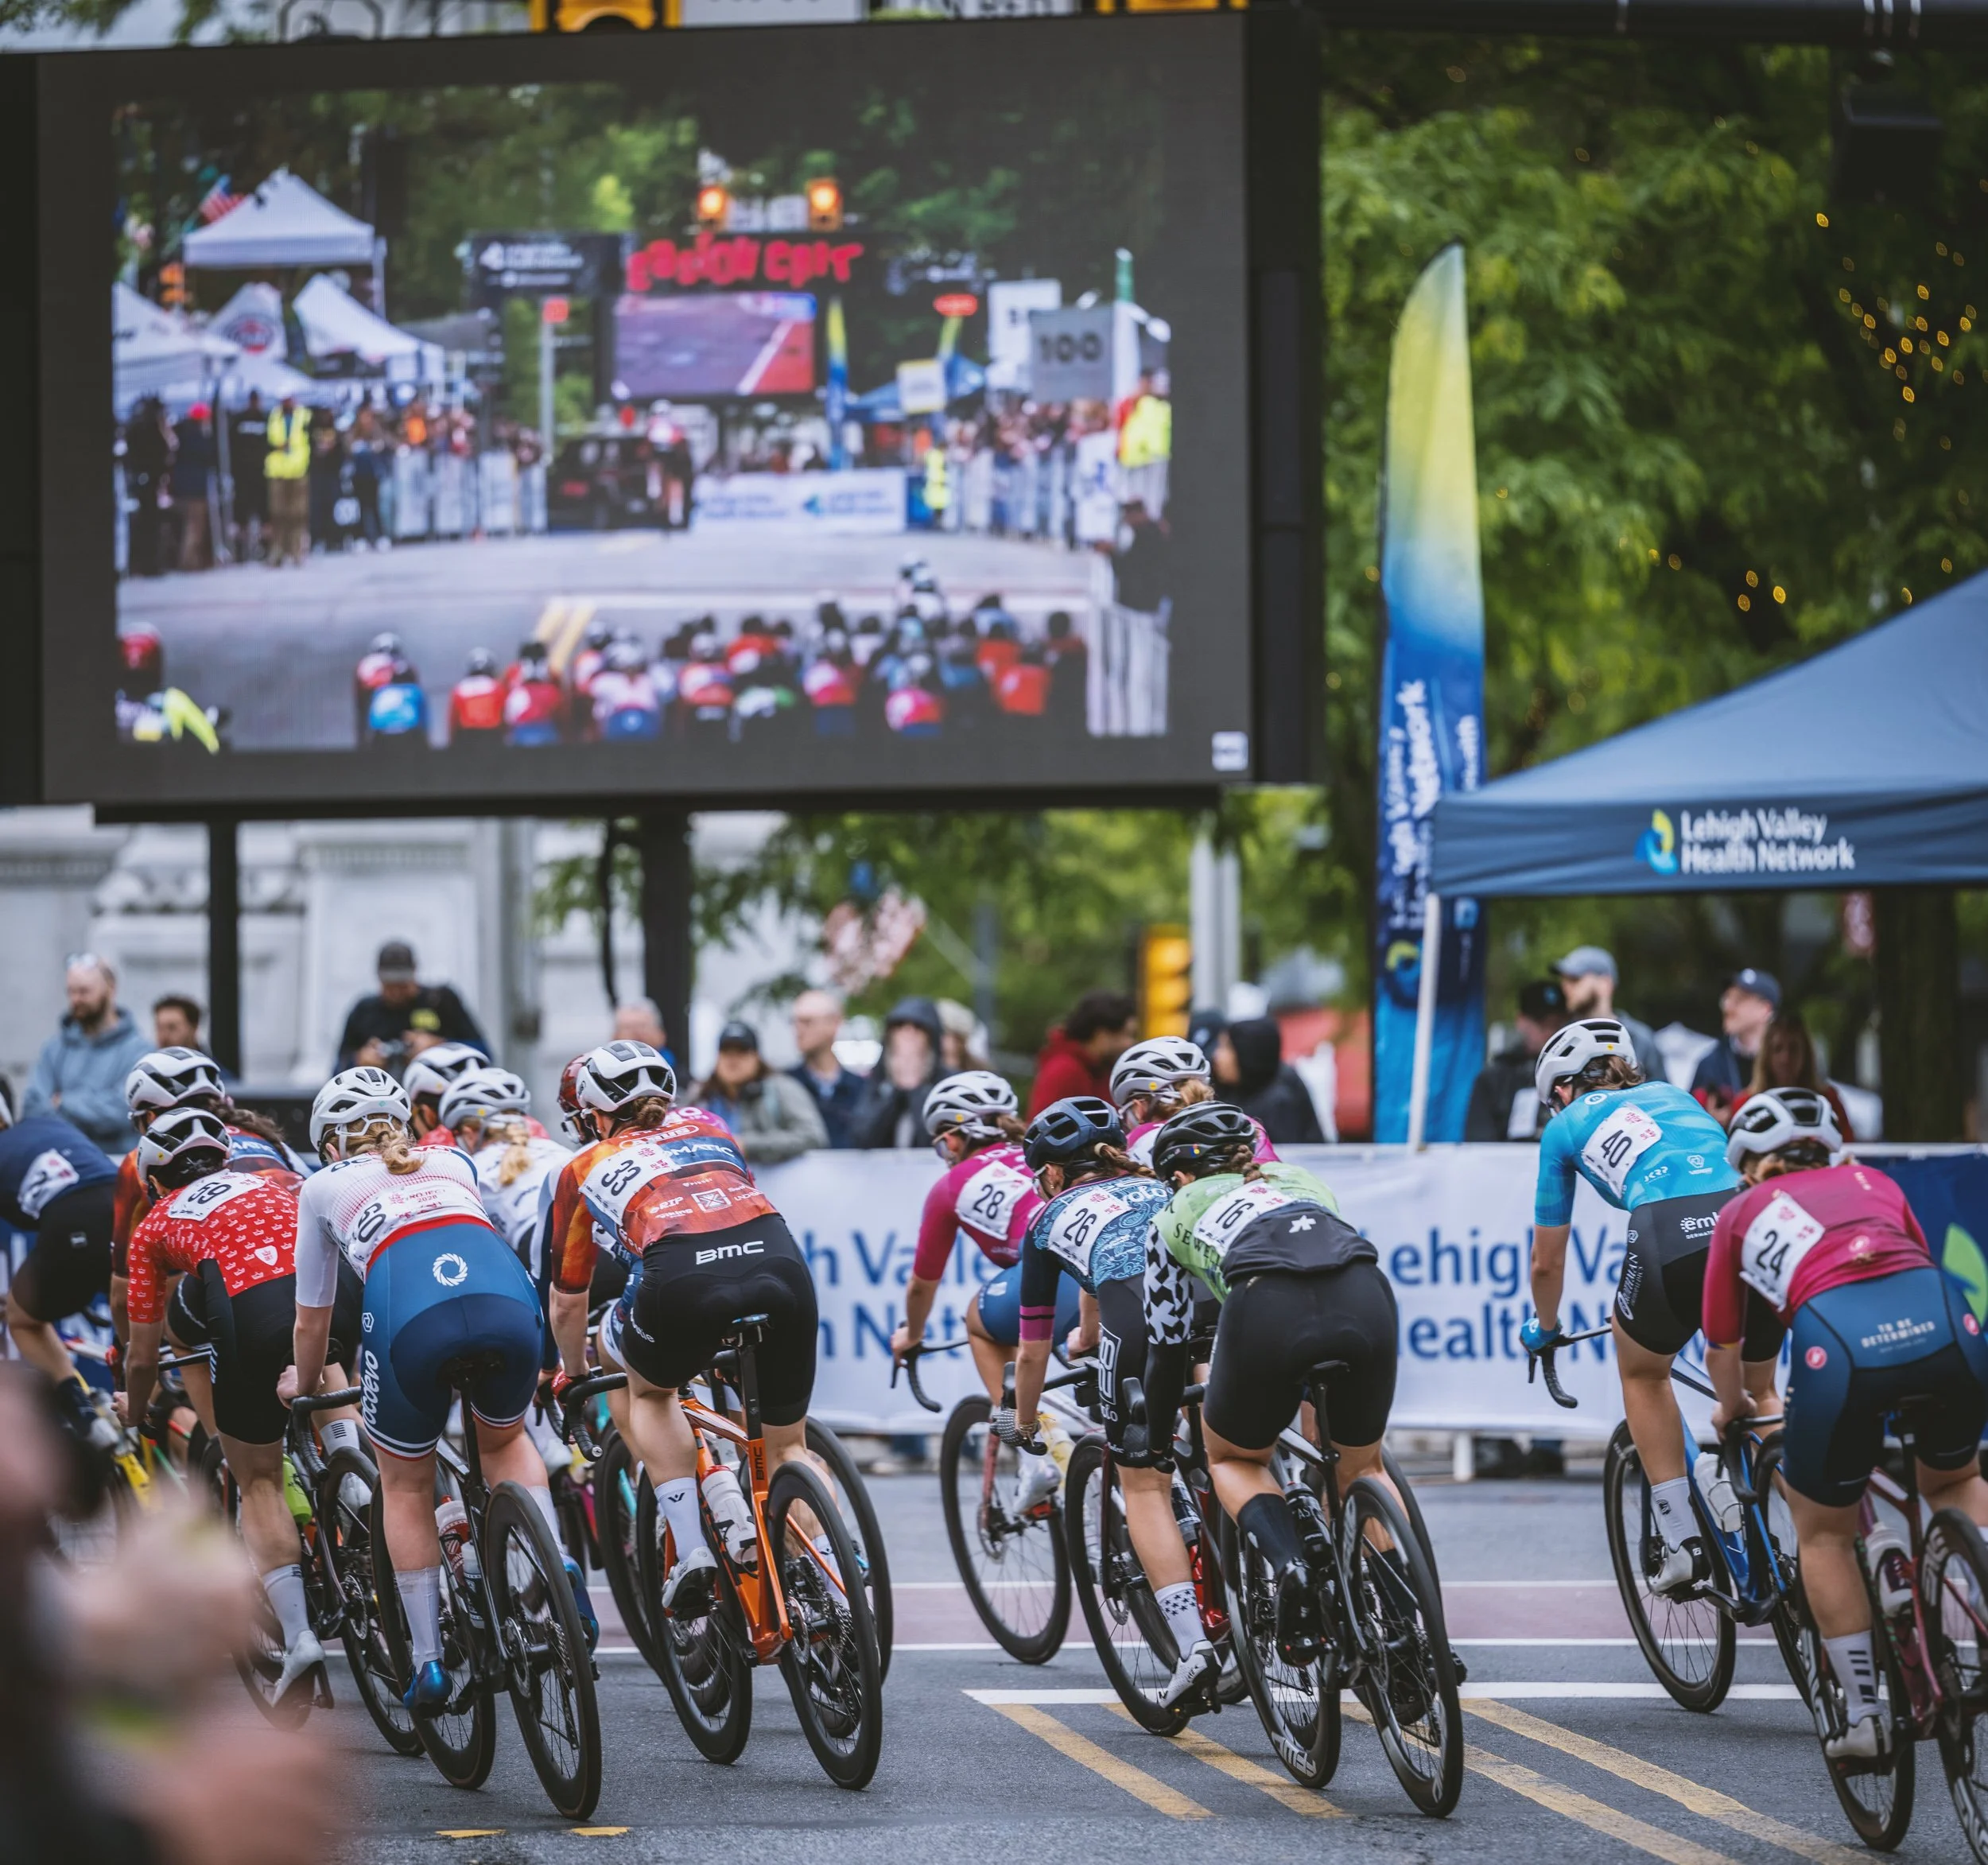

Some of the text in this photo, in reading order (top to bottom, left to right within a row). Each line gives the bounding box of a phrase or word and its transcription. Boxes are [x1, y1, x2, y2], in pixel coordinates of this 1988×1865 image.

[1039, 331, 1102, 364] 100
[1680, 806, 1827, 845] Lehigh Valley
[1681, 835, 1855, 874] Health Network
[1601, 1129, 1633, 1168] 40
[188, 1182, 232, 1204] 59
[601, 1160, 641, 1196] 33
[973, 1183, 1005, 1219] 28
[1216, 1198, 1254, 1230] 16
[1063, 1207, 1097, 1247] 26
[696, 1241, 764, 1265] BMC
[1388, 1225, 1535, 1300] ehig
[1756, 1230, 1791, 1280] 24
[1861, 1320, 1936, 1349] DETERMINED
[1877, 1317, 1912, 1334] TO BE
[753, 1446, 765, 1481] BMC
